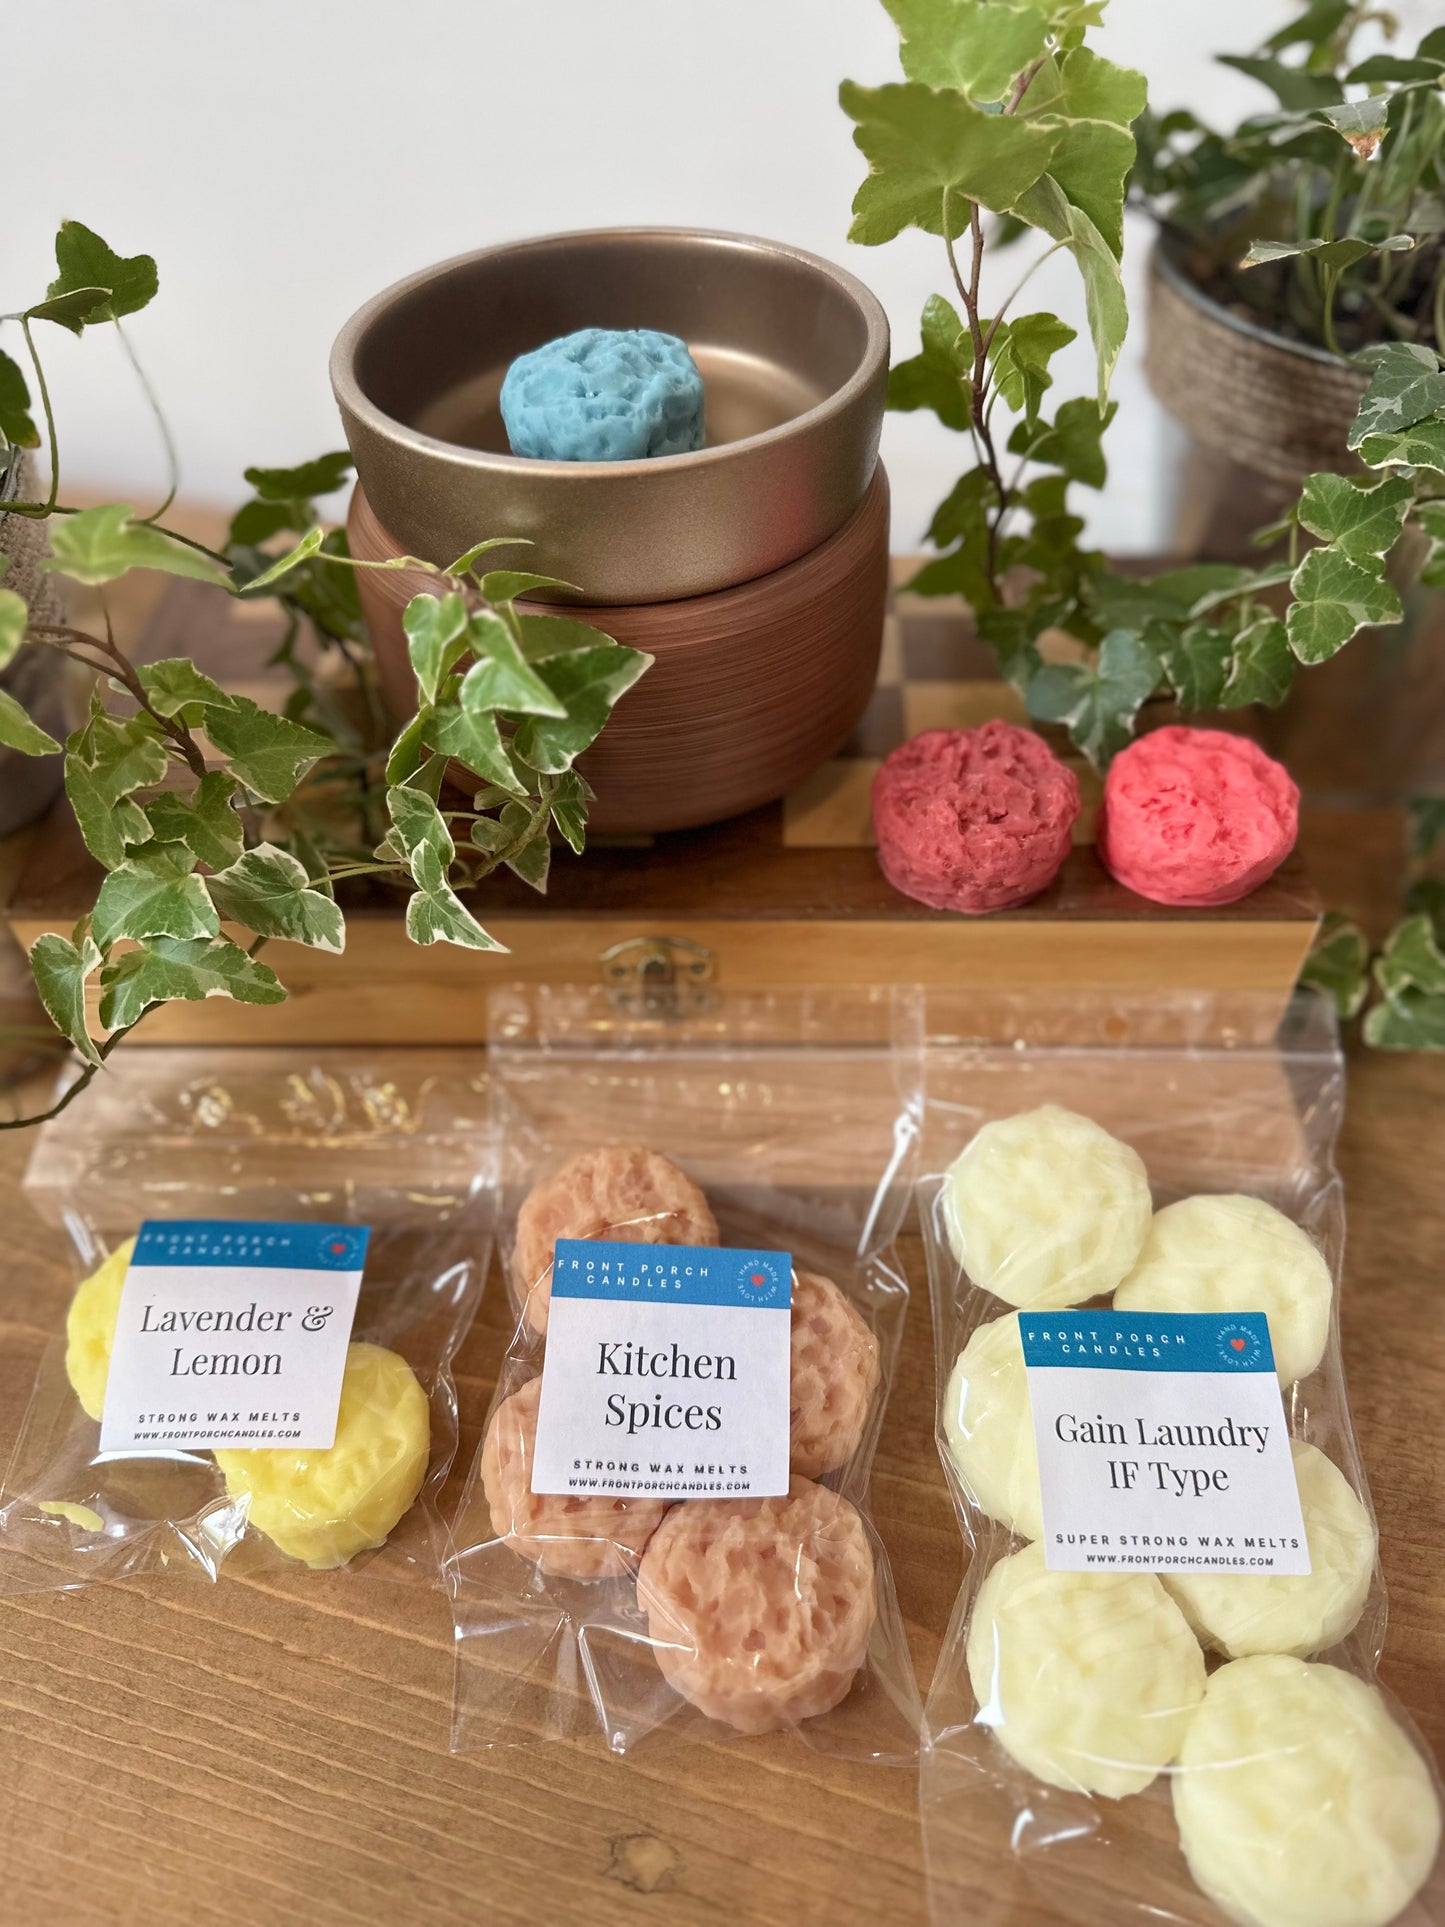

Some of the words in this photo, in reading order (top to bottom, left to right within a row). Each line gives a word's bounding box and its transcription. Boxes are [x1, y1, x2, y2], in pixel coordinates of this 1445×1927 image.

[557, 1259, 625, 1272] FRONT
[641, 1264, 709, 1277] PORCH
[586, 1274, 682, 1289] CANDLES
[140, 1303, 293, 1332] Lavender
[301, 1305, 334, 1332] &
[1028, 1331, 1098, 1341] FRONT
[1115, 1332, 1186, 1344] PORCH
[1062, 1344, 1161, 1357] CANDLES
[170, 1348, 283, 1376] Lemon
[596, 1341, 738, 1380] Kitchen
[138, 1413, 198, 1423] STRONG
[207, 1412, 240, 1422] WAX
[248, 1412, 301, 1422] MELTS
[605, 1393, 722, 1434] Spices
[133, 1430, 302, 1440] WWW.FRONTPORCHCANDLES.COM
[1055, 1413, 1128, 1445] Gain
[1134, 1417, 1269, 1454] Laundry
[573, 1460, 640, 1473] STRONG
[649, 1463, 684, 1474] WAX
[694, 1464, 748, 1475] MELTS
[568, 1477, 751, 1490] WWW.FRONTPORCHCANDLES.COM
[1107, 1460, 1139, 1489] IF
[1148, 1461, 1230, 1497] Type
[1055, 1533, 1110, 1545] SUPER
[1119, 1535, 1188, 1546] STRONG
[1199, 1536, 1235, 1547] WAX
[1244, 1537, 1300, 1548] MELTS
[1086, 1554, 1274, 1567] WWW.FRONTPORCHCANDLES.COM
